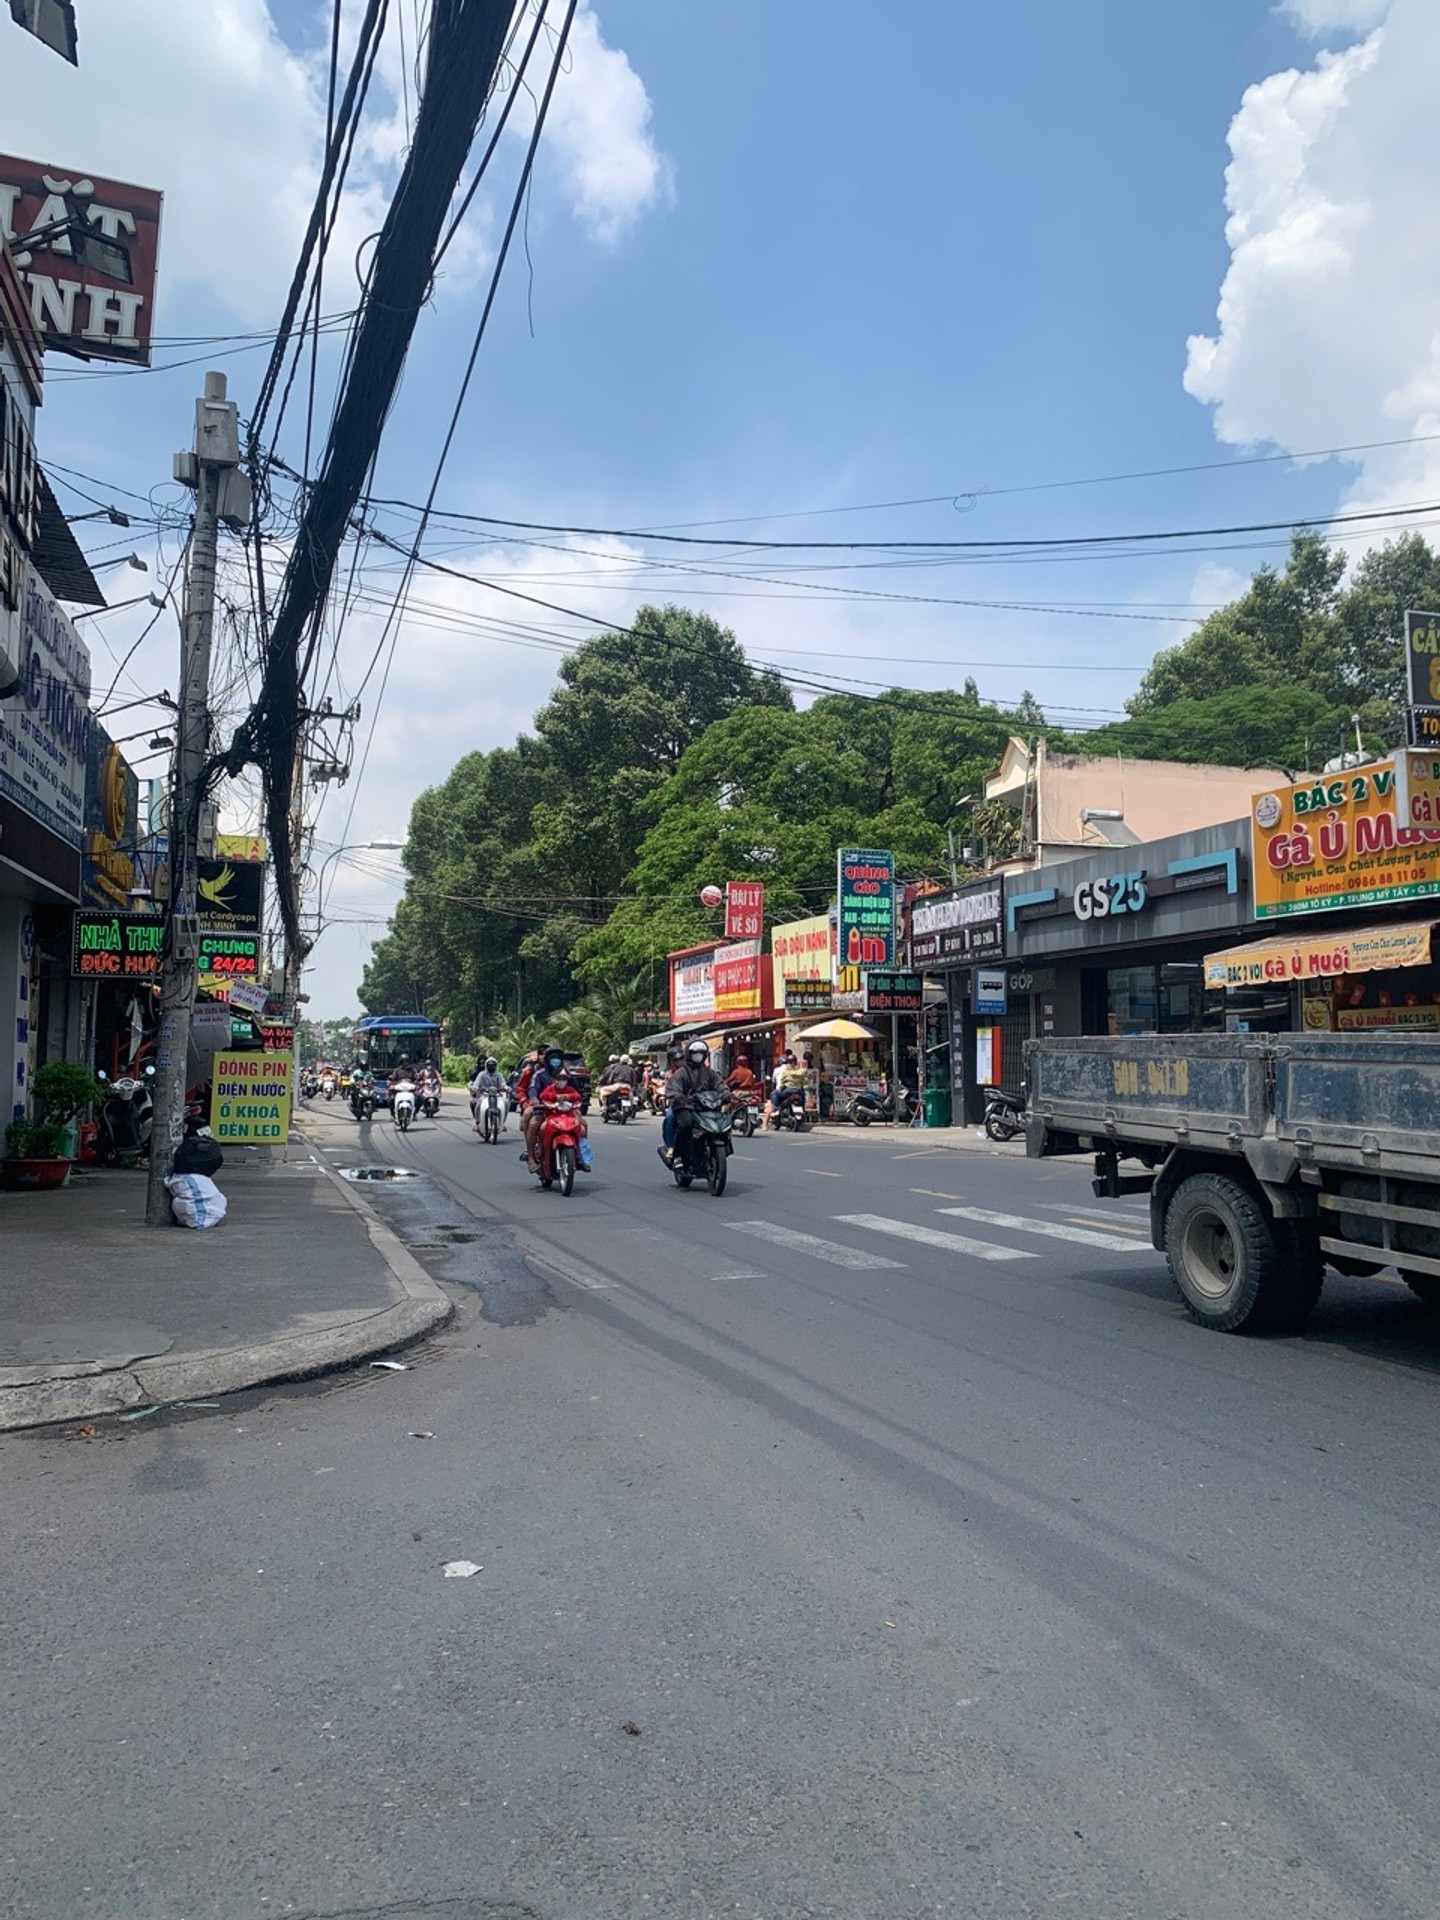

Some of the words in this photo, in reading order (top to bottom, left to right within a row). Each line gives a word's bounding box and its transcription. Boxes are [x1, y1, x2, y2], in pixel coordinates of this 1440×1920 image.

[1412, 618, 1440, 654] CẮ
[1293, 780, 1348, 815] BÁC
[1351, 776, 1368, 802] 2
[1372, 769, 1396, 797] V
[1267, 824, 1313, 869] Gà
[1320, 811, 1346, 859] Ủ
[844, 864, 890, 880] QUẢNG
[1326, 864, 1346, 875] Con
[854, 880, 880, 894] CÁO
[1305, 882, 1344, 896] Hotline:
[1348, 876, 1376, 889] 0986
[1379, 872, 1393, 884] 88
[1397, 870, 1408, 882] 11
[1411, 868, 1426, 880] 05
[731, 888, 748, 910] ĐẠI
[749, 888, 760, 907] LÝ
[1074, 869, 1147, 922] GS25
[1392, 887, 1409, 897] TÂY
[210, 910, 257, 923] Cordyceps
[731, 915, 743, 933] VÉ
[745, 915, 758, 933] SỐ
[80, 919, 122, 950] NHÀ
[126, 926, 164, 952] THU
[202, 939, 255, 955] CHƯNG
[774, 936, 788, 958] SỮA
[790, 932, 804, 956] ĐẬU
[81, 951, 121, 972] ĐỨC
[212, 956, 255, 971] 24/24
[1265, 956, 1286, 977] Gà
[1291, 949, 1302, 975] Ủ
[1309, 946, 1349, 973] Muối
[1010, 969, 1033, 989] GÓP
[869, 992, 891, 1009] ĐIỆN
[892, 995, 920, 1009] THOẠI
[219, 1058, 258, 1076] ĐÓNG
[262, 1062, 287, 1077] PIN
[217, 1081, 247, 1099] ĐIỆN
[251, 1081, 286, 1097] NƯỚC
[236, 1104, 280, 1118] KHOÁ
[218, 1121, 248, 1137] ĐÈN
[254, 1125, 280, 1137] LED
